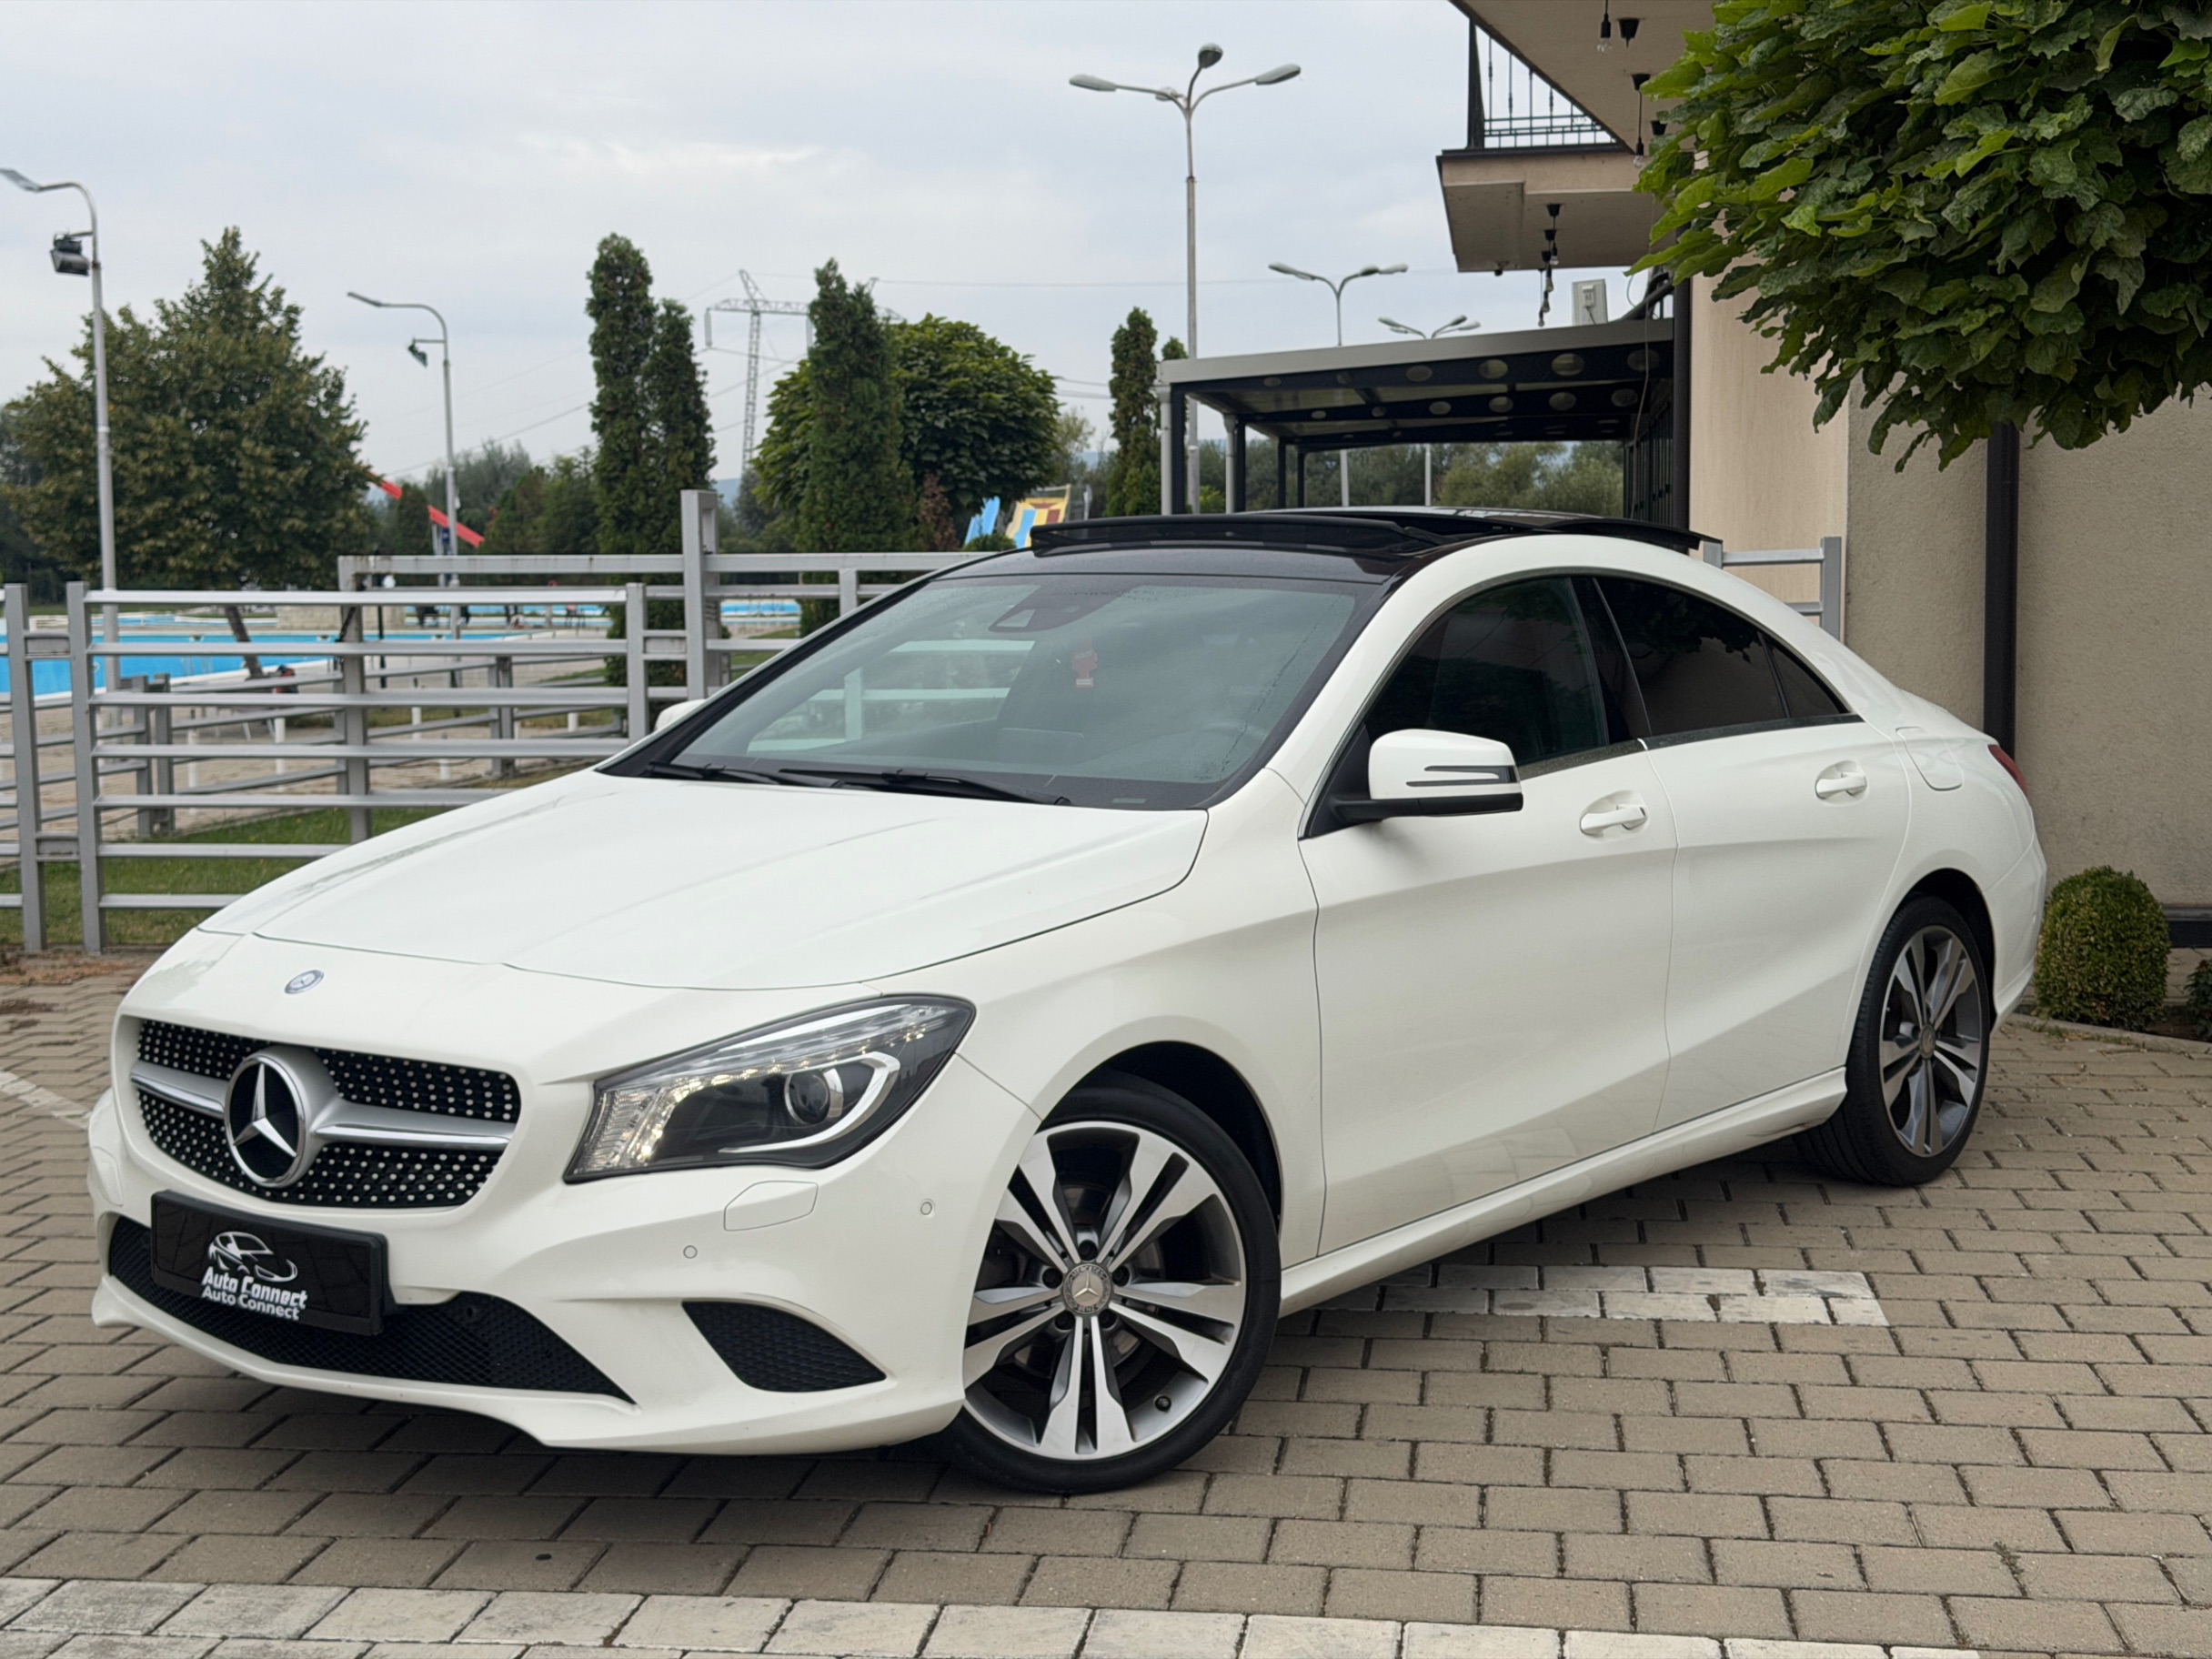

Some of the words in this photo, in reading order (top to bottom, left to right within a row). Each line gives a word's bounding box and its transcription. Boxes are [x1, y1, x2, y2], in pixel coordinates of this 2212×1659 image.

[202, 1266, 238, 1292] Auto
[241, 1275, 307, 1309] Connect
[202, 1285, 236, 1306] Auto
[238, 1293, 299, 1321] Connect
